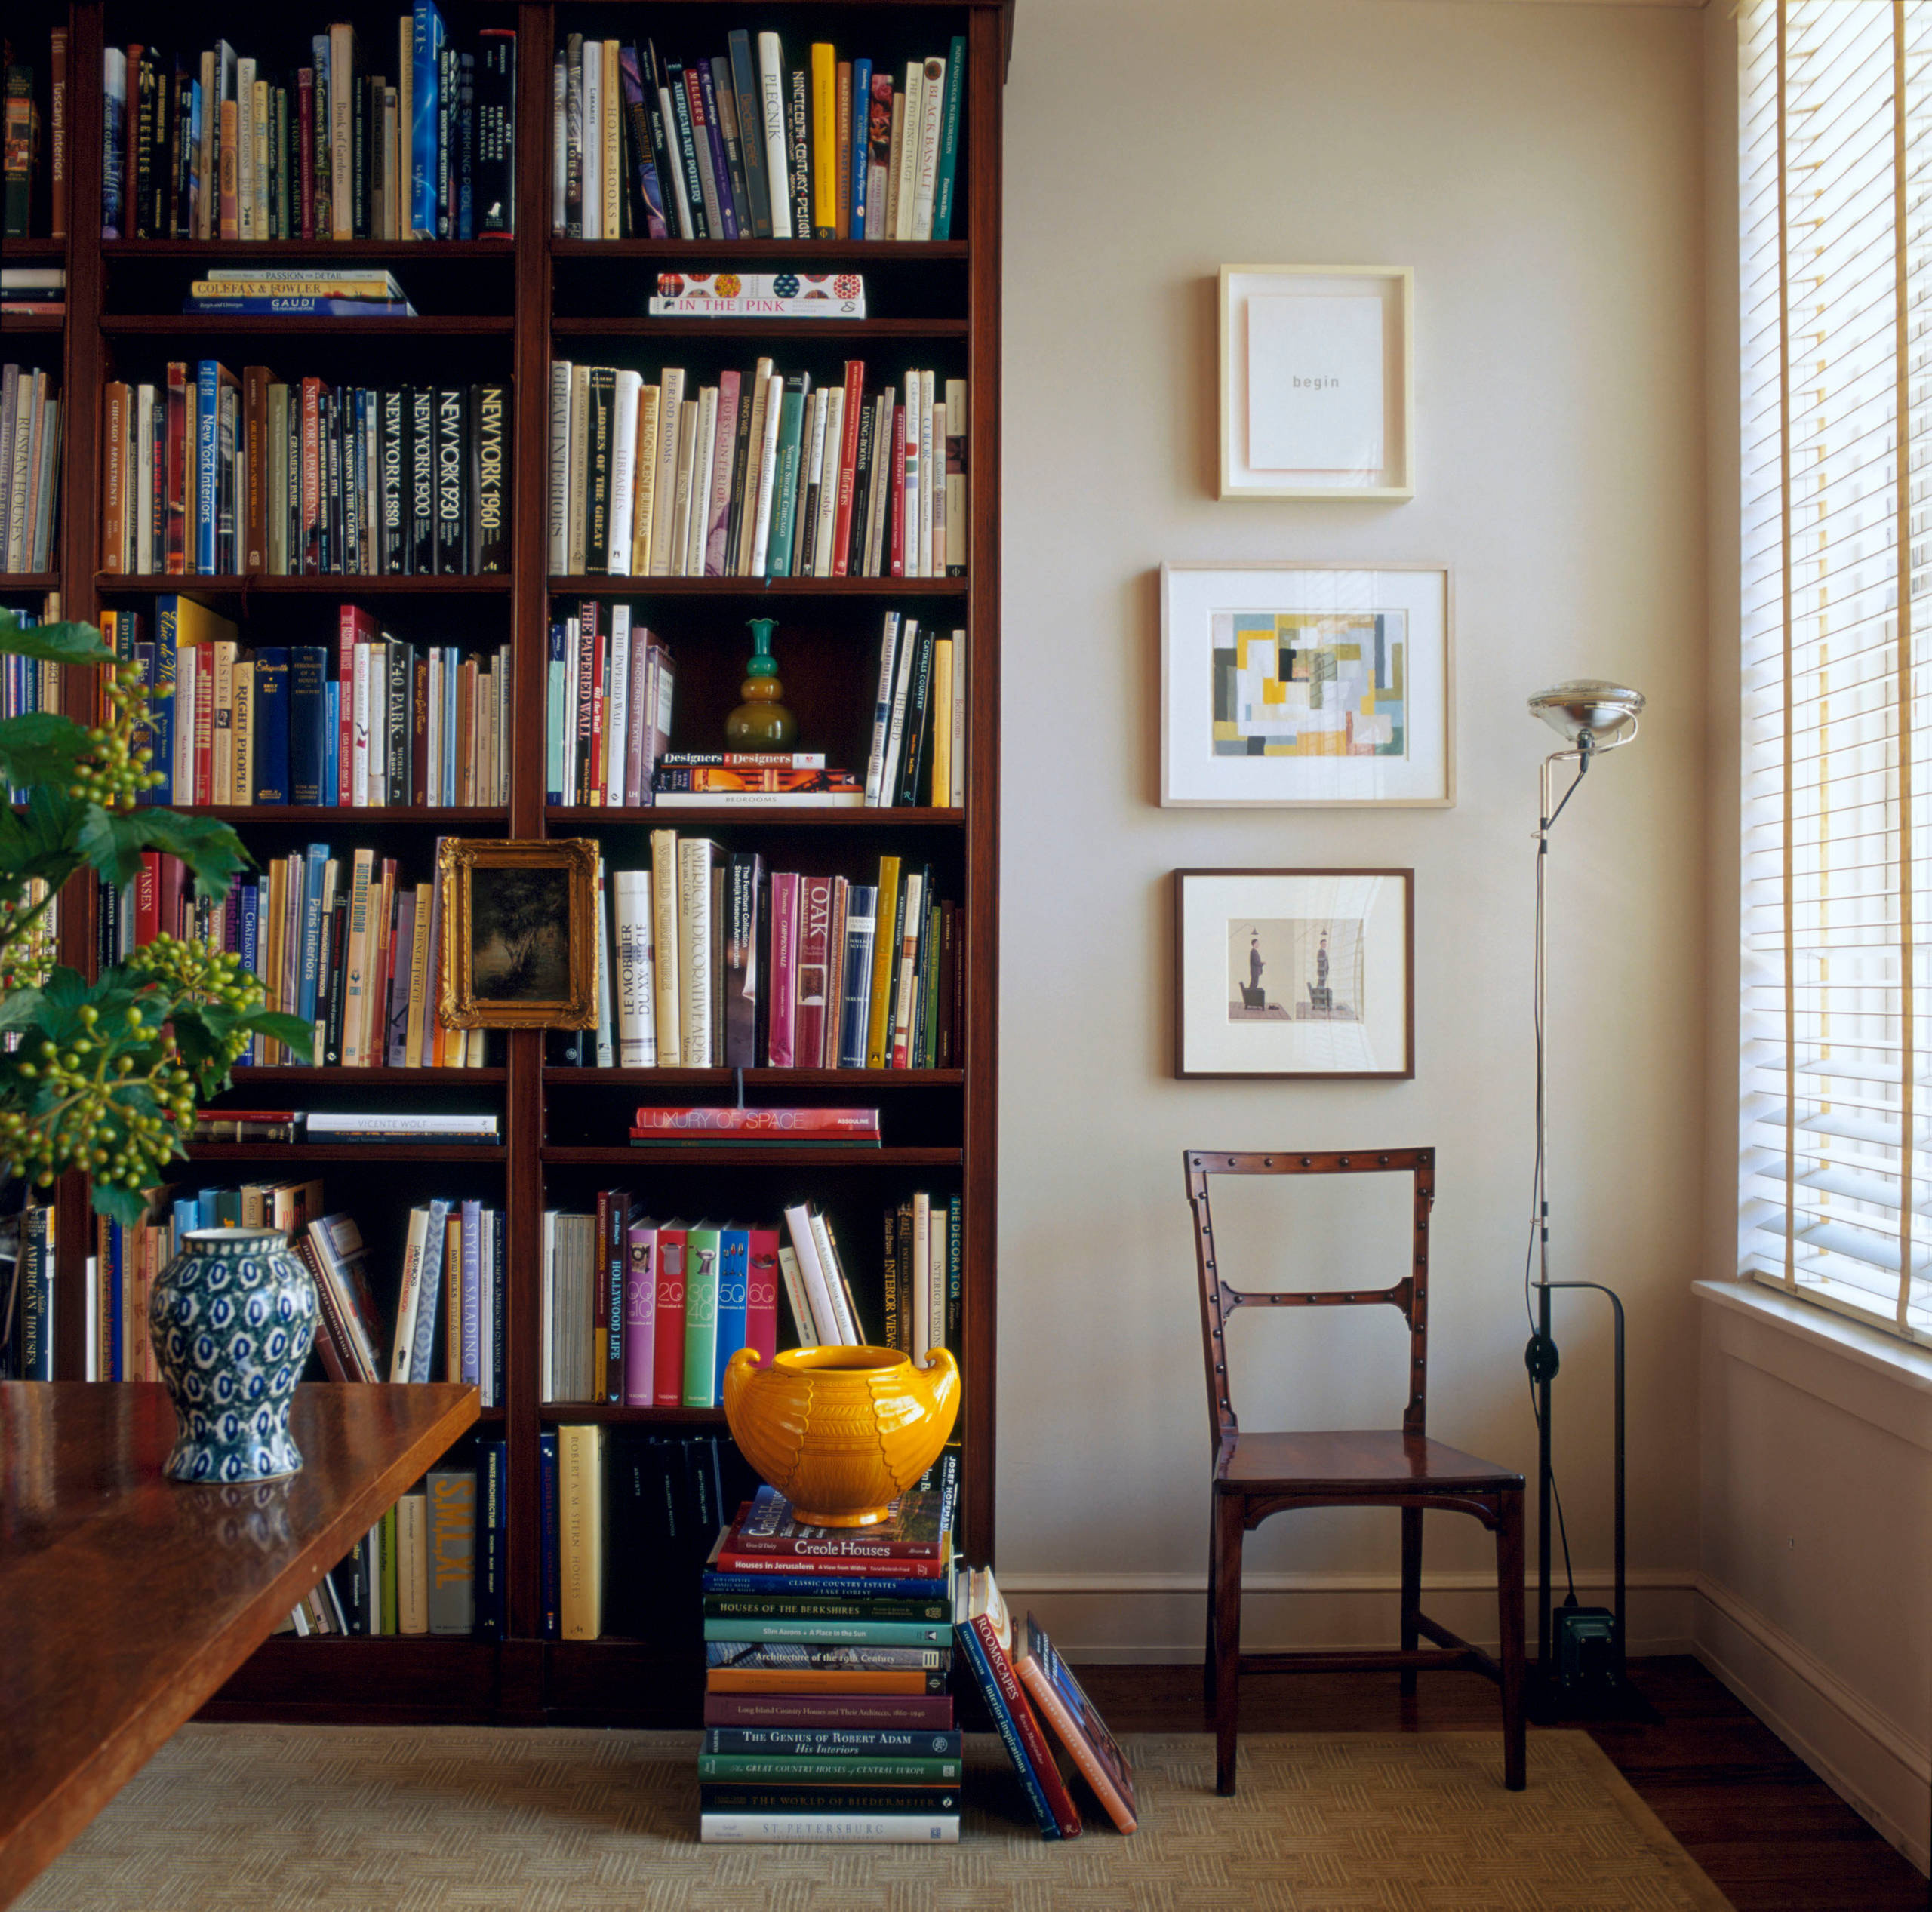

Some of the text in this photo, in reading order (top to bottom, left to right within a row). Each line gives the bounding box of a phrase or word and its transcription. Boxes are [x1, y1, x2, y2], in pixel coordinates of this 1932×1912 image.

[51, 81, 66, 180] Tuscany Interiors
[140, 103, 152, 173] TRELLIS
[673, 81, 703, 203] AMERICAN ART POTTERY
[740, 93, 759, 168] Biedermeier
[792, 71, 811, 238] NINETEENTH CENTURY DESIGN
[921, 85, 938, 191] BLACK BASALT
[198, 283, 321, 295] COLEFAX & FOWLER
[679, 300, 785, 312] IN THE PINK
[663, 374, 677, 463] PERIOD ROOMS
[1293, 376, 1339, 390] begin
[202, 414, 212, 523] New York Interiors
[289, 435, 297, 484] GRAMERCY
[306, 386, 316, 525] NEW YORK APARTMENTS
[346, 434, 354, 478] MANSIONS
[386, 392, 401, 527] NEW YORK 1880
[414, 393, 431, 515] NEW YORK 1900
[440, 392, 460, 519] NEW YORK 1930
[480, 389, 502, 529] NEW YORK 1960
[551, 366, 567, 536] GREAT INTERIORS
[639, 401, 657, 536] THE MAGNIFICENT BUILDERS
[857, 406, 871, 470] LIVING-ROOMS
[896, 452, 904, 484] hardware
[12, 417, 31, 541] RUSSIAN HOUSES
[109, 446, 119, 506] APARTMENTS
[346, 481, 354, 489] IN
[593, 406, 607, 549] HOMES OF THE GREAT
[780, 444, 795, 537] NORTH SHORE CHICAGO
[347, 512, 356, 547] CLOUDS
[392, 660, 405, 734] 740 PARK
[578, 602, 594, 740] THE PAPERED WALL
[916, 639, 931, 709] CATSKILLS COUNTRY
[235, 686, 248, 792] RIGHT PEOPLE
[891, 690, 907, 740] THE BED
[955, 698, 963, 739] Bedrooms
[663, 753, 791, 764] Designers Designers
[140, 865, 152, 911] JANSEN
[742, 880, 750, 911] Furniture
[809, 886, 829, 938] OAK
[306, 898, 321, 980] Paris Interiors
[692, 844, 706, 1064] AMERICAN DECORATIVE ARTS
[643, 1112, 711, 1128] LUXURY
[716, 1112, 740, 1128] OF
[746, 1112, 804, 1128] SPACE
[951, 1198, 961, 1298] THE DECORATOR
[26, 1243, 38, 1365] AMERICAN HOUSES
[464, 1222, 477, 1365] STYLE BY SALADINO
[611, 1260, 622, 1359] HOLLYWOOD LIFE
[885, 1259, 897, 1350] INTERIOR VIEWS
[735, 1561, 764, 1570] Houses
[774, 1562, 814, 1571] Jerusalem
[794, 1540, 891, 1557] Creole Houses
[721, 1603, 860, 1615] HOUSES OF THE BERKSHIRES
[763, 1628, 780, 1636] Slim
[755, 1652, 894, 1663] Architecture of the 19th Century
[976, 1617, 1019, 1700] ROOMSCAPES
[743, 1731, 911, 1744] THE GENIUS OF ROBERT ADAM
[795, 1744, 859, 1754] His Interiors
[984, 1684, 1026, 1773] interior inspirations
